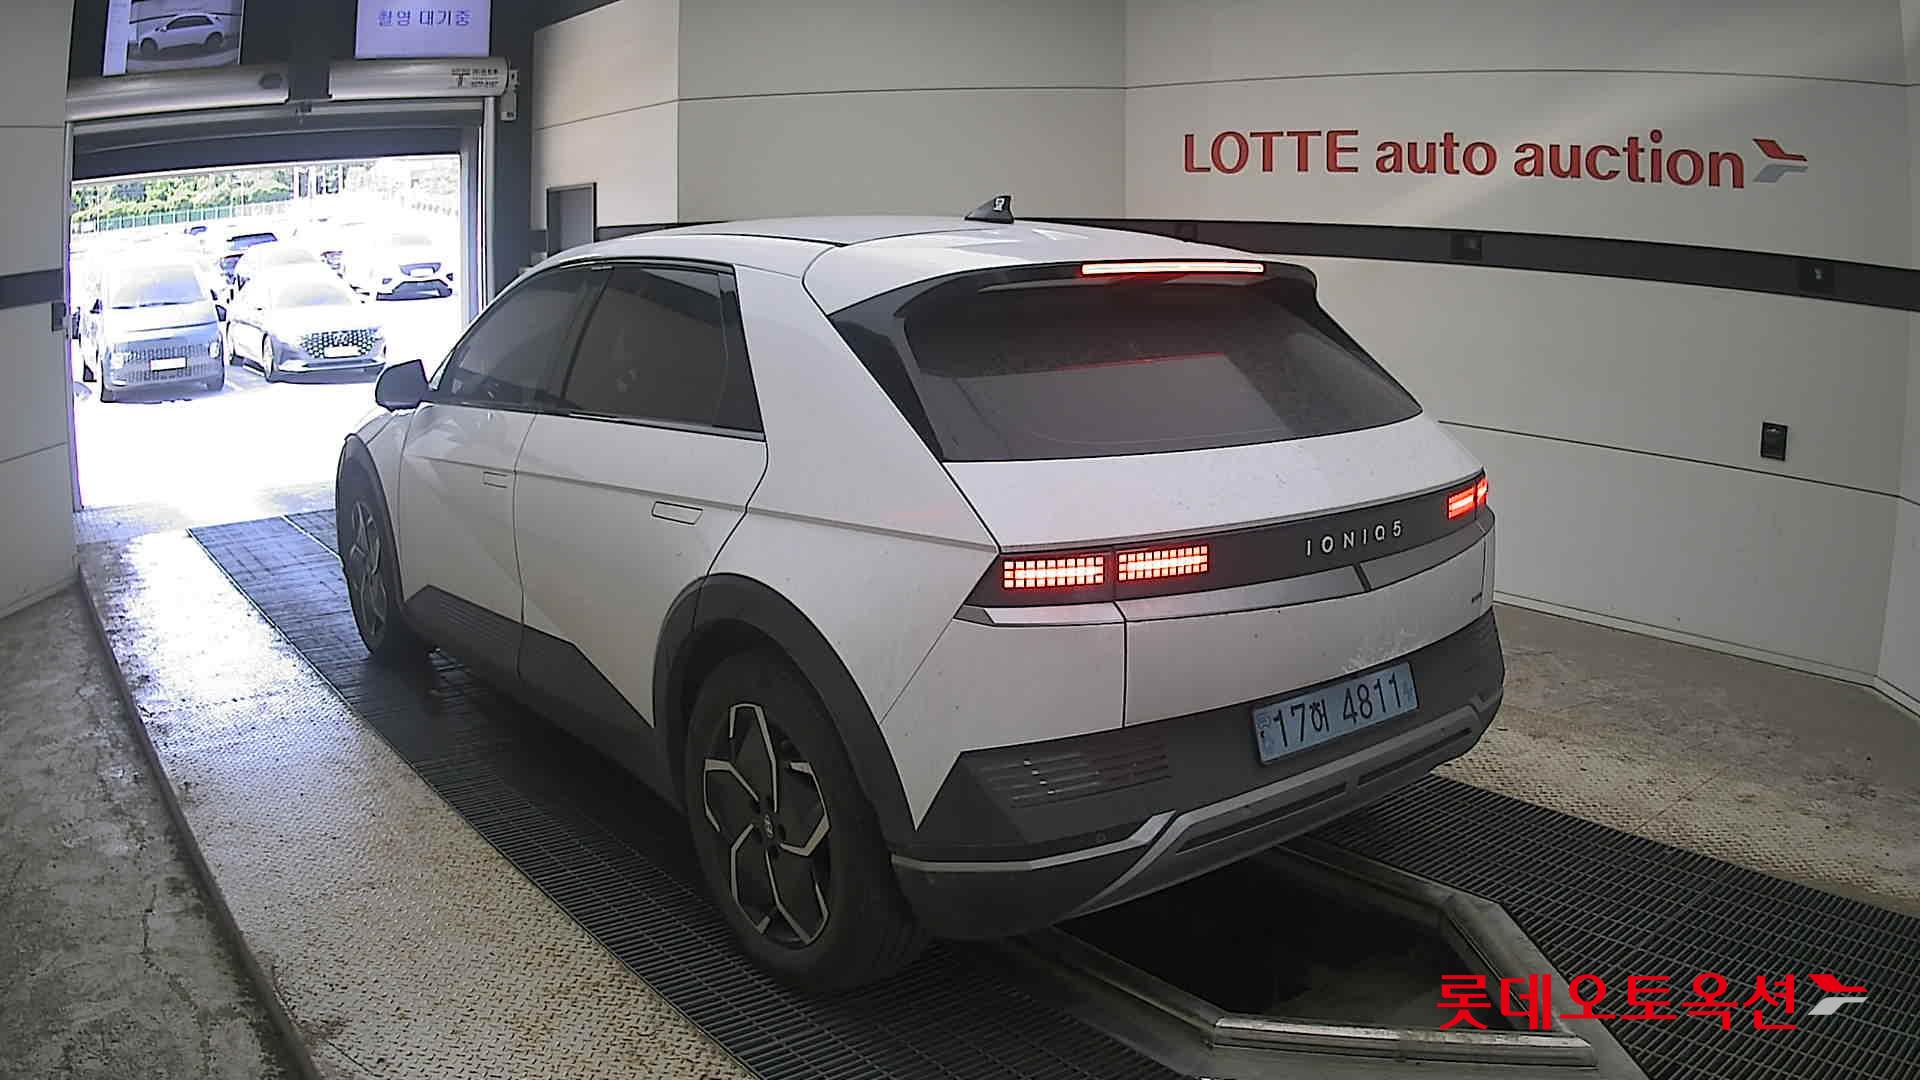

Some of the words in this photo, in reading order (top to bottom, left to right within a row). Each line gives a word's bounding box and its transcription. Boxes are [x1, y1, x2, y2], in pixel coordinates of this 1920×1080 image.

[419, 9, 472, 27] 대기중
[1184, 130, 1359, 174] LOTTE
[1376, 131, 1497, 176] auto
[1514, 130, 1745, 188] auction
[1273, 698, 1330, 748] 17허
[1342, 671, 1402, 725] 4811
